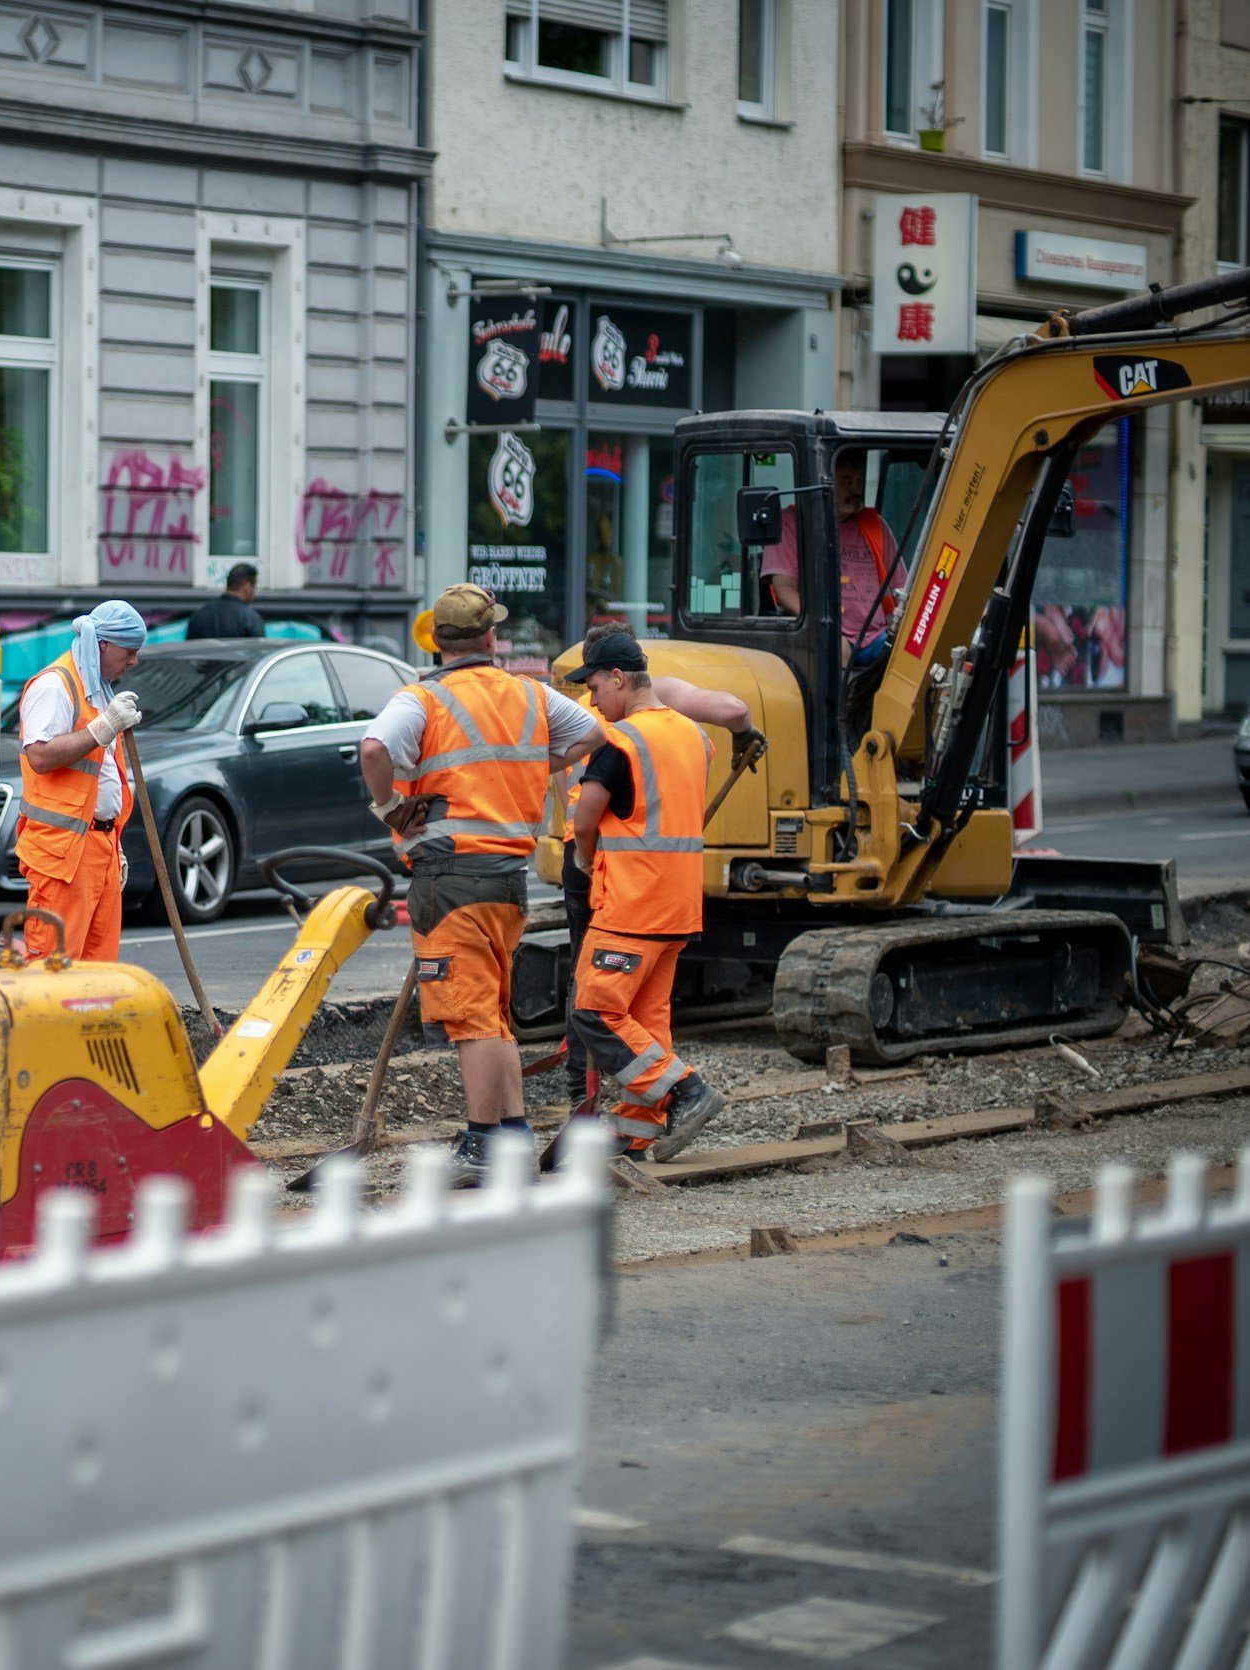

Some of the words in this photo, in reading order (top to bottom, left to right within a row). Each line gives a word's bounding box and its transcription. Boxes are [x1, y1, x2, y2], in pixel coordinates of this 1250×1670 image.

[492, 356, 518, 382] 66
[1119, 359, 1158, 397] CAT
[502, 457, 525, 499] 66
[953, 508, 965, 533] hier
[469, 561, 547, 593] GEÖFFNET
[913, 584, 941, 645] ZEPPELIN
